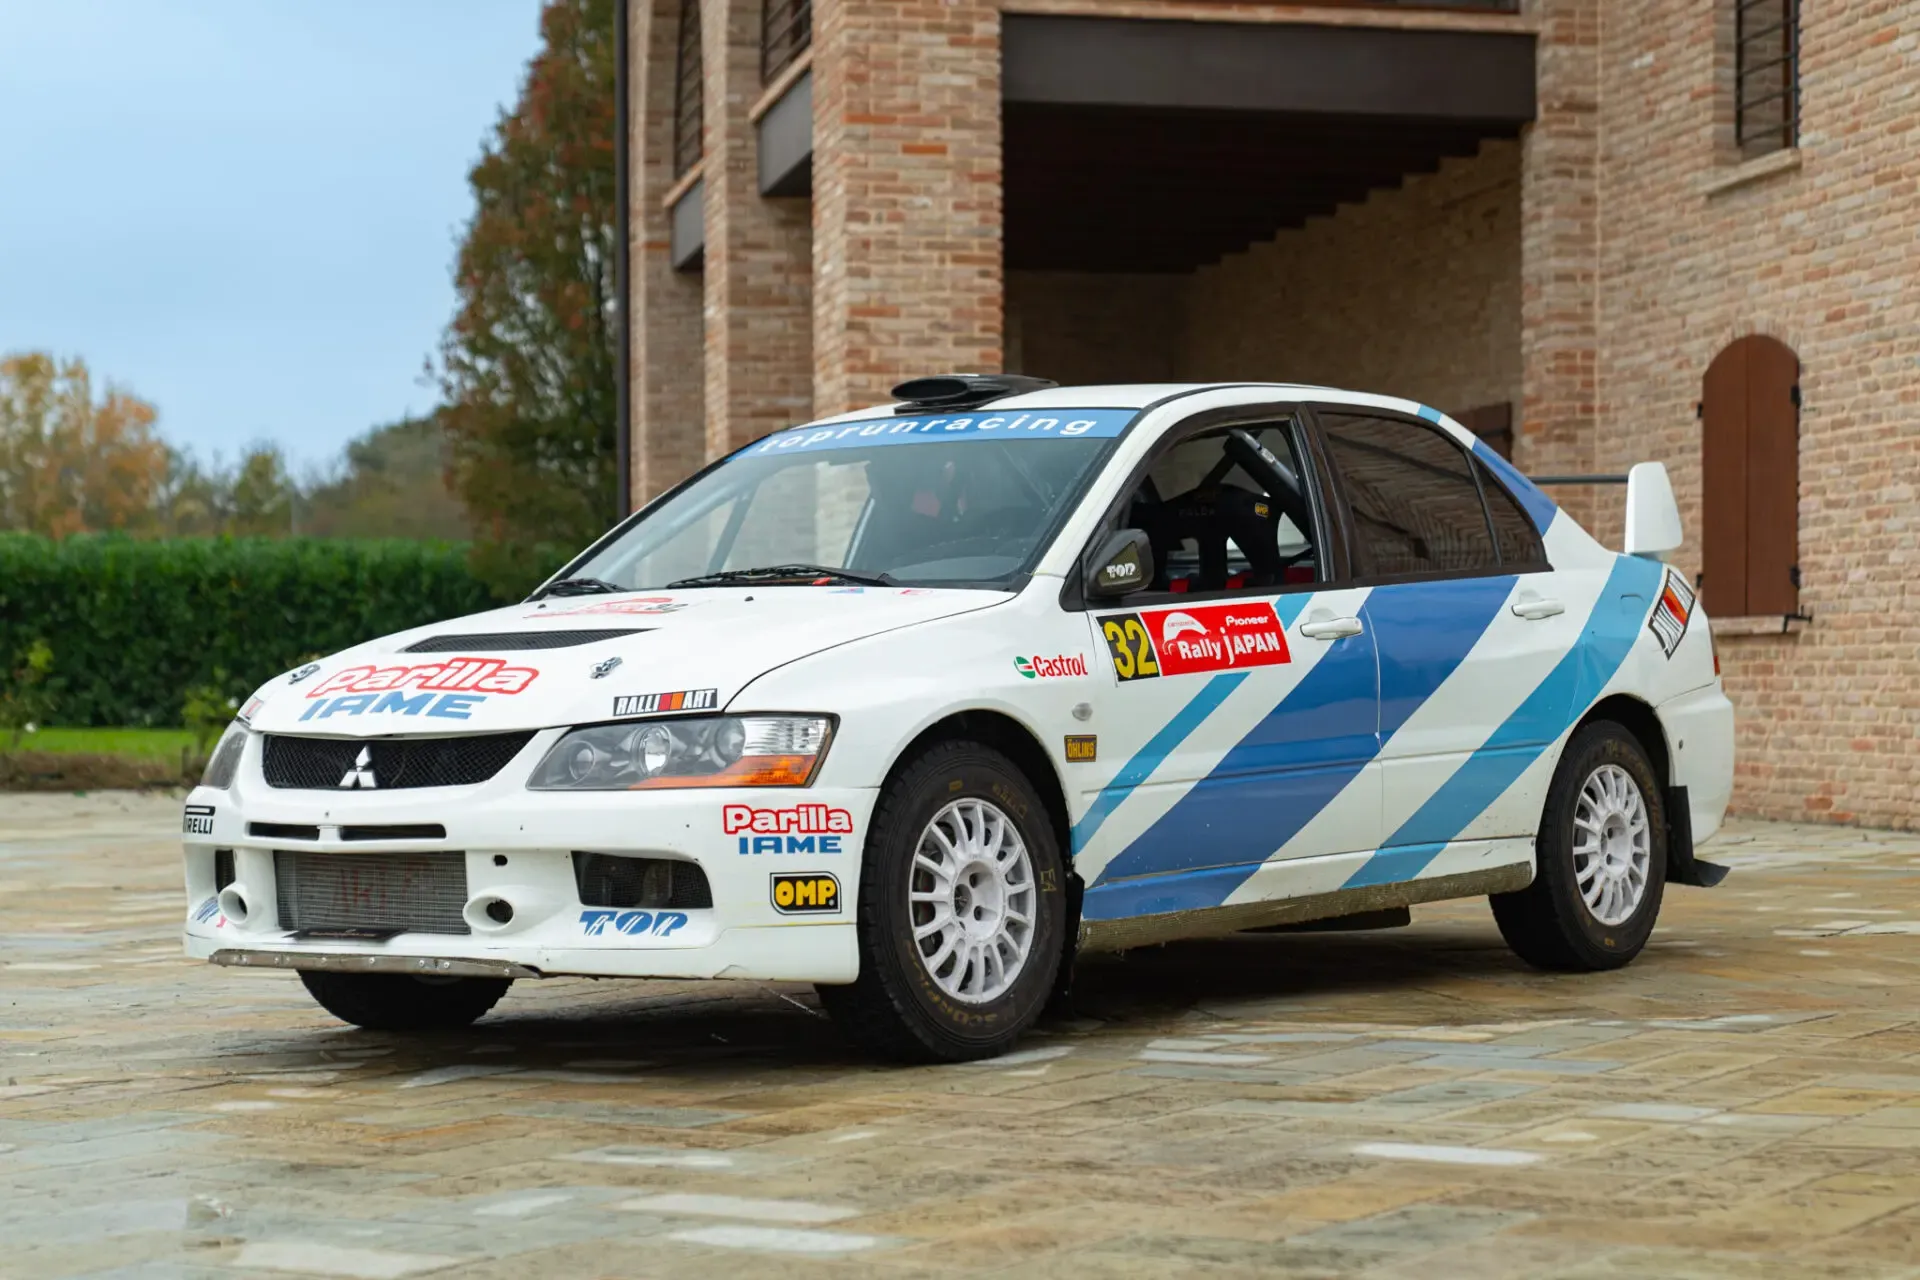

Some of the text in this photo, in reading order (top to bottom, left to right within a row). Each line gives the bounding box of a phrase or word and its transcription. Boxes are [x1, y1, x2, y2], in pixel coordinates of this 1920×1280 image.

[759, 413, 1097, 451] toprunracing
[1106, 562, 1136, 579] TOP
[1226, 615, 1268, 627] Pioneer
[1103, 619, 1158, 679] 32
[1177, 638, 1222, 661] Rally
[305, 657, 540, 698] Parilla
[1033, 652, 1088, 677] Castrol
[298, 691, 488, 722] IAME
[723, 804, 853, 835] Parilla
[739, 836, 843, 855] IAME
[579, 910, 688, 937] TOP
